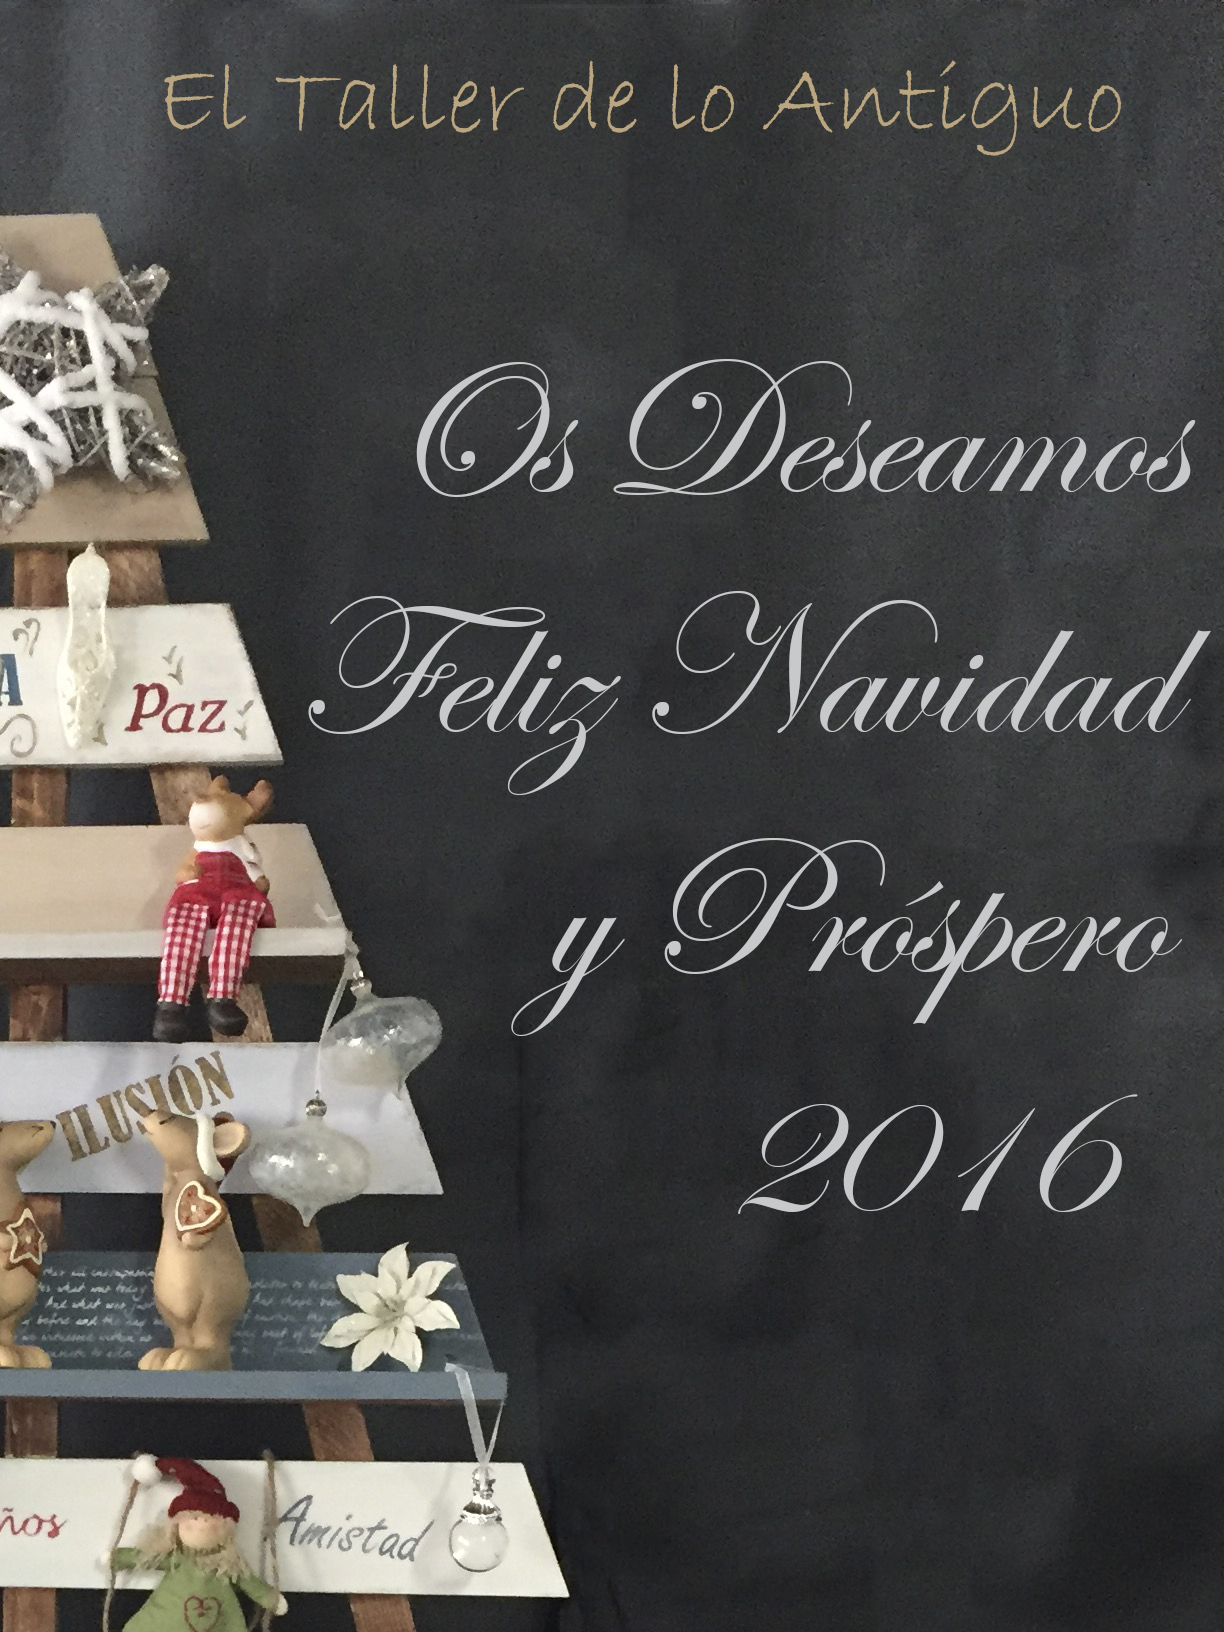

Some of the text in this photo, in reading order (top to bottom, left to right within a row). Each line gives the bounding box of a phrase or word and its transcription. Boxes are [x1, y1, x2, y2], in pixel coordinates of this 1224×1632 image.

[124, 681, 228, 734] Paz
[56, 1050, 235, 1163] ILUSIÓN
[277, 1494, 435, 1563] Amistad
